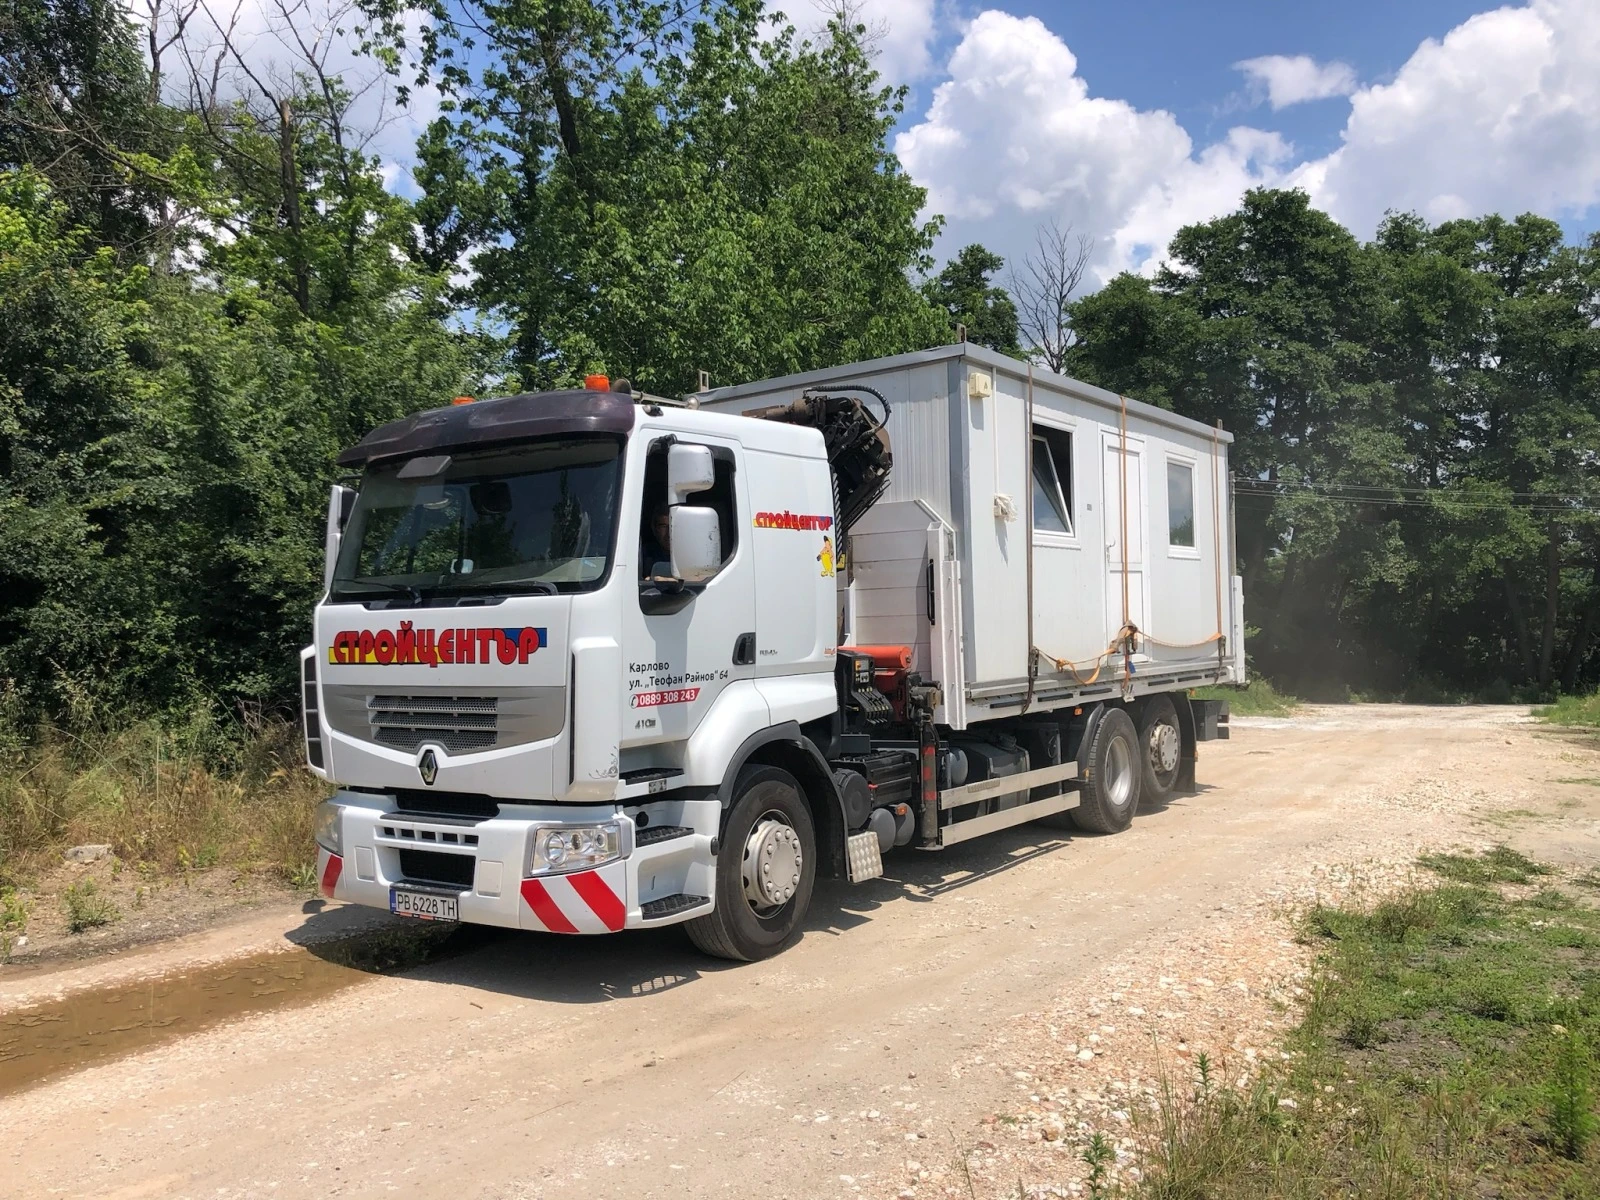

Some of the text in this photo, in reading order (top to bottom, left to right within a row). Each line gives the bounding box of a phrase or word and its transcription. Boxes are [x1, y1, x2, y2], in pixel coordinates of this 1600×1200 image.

[754, 510, 832, 532] СТРОЙЦЕНТЪР
[333, 621, 540, 668] СТРОЙЦЕНТЪР
[629, 662, 670, 675] Карлово
[629, 679, 643, 691] ул.
[719, 669, 729, 680] 64
[639, 689, 696, 706] 0889 308 243
[413, 896, 439, 914] 6228
[440, 900, 455, 916] TH
